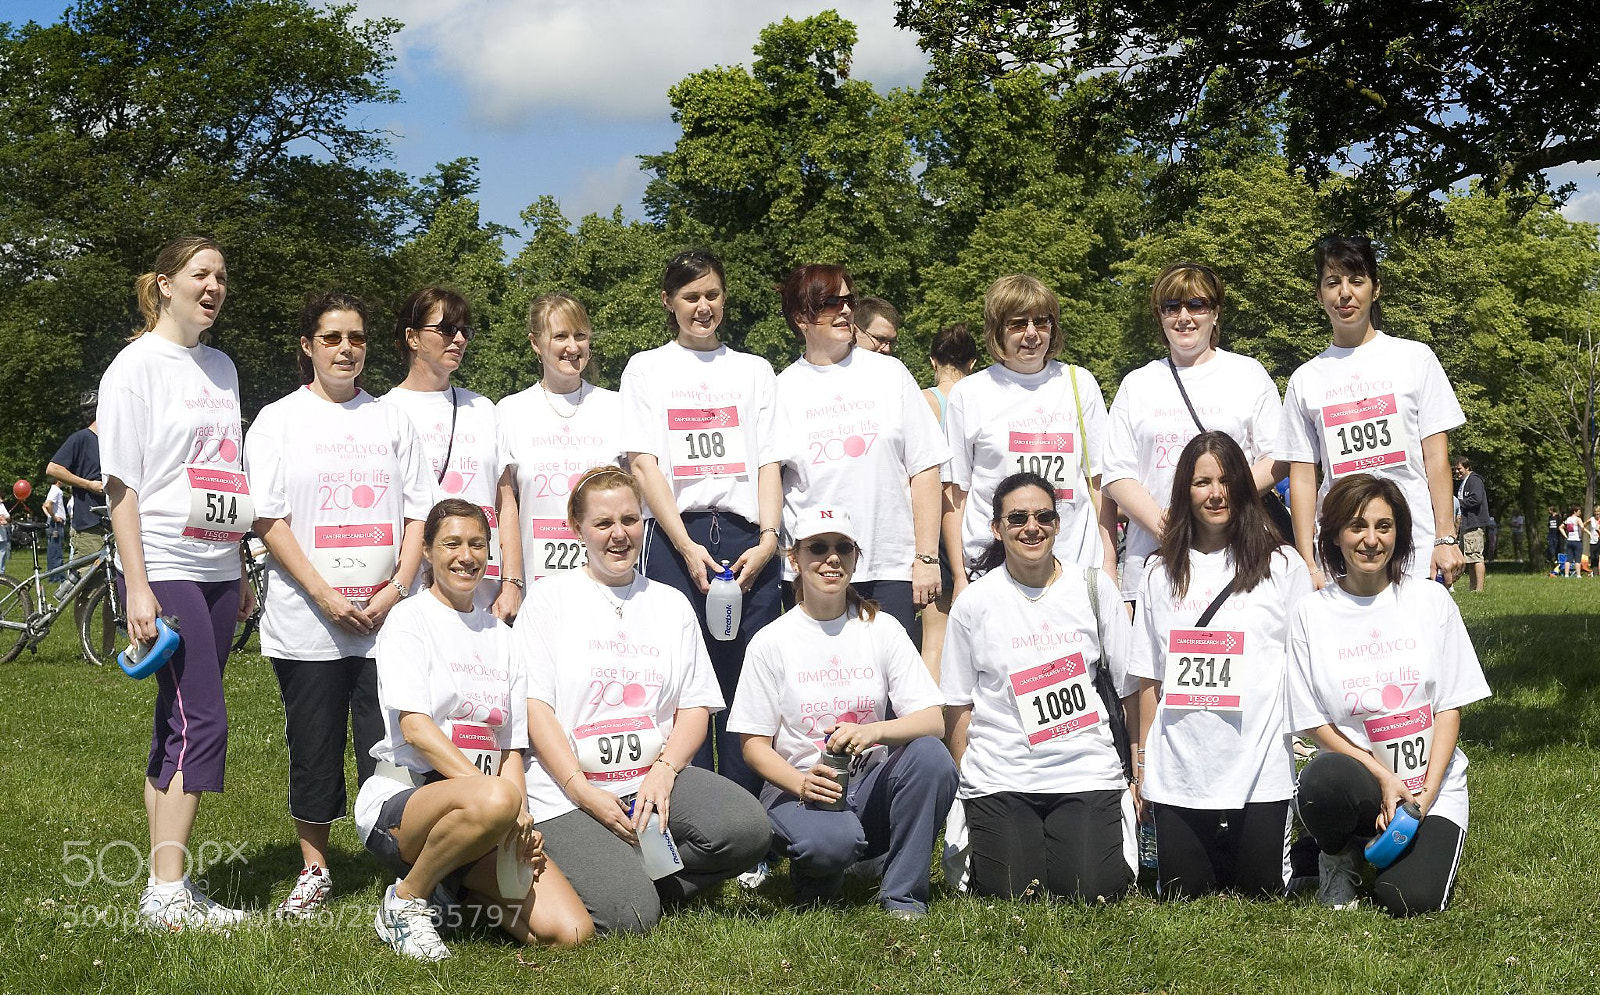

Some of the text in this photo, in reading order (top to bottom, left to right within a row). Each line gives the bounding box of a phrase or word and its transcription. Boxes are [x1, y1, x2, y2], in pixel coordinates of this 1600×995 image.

[671, 390, 742, 403] BMPOLYCO
[1324, 381, 1393, 401] BMPOLYCO
[184, 398, 235, 410] BMPOLYCO
[806, 400, 876, 420] BMPOLYCO
[195, 426, 214, 437] race
[216, 422, 229, 437] for
[808, 420, 880, 440] race for life
[1155, 433, 1179, 444] race
[1181, 429, 1196, 443] fo
[1337, 419, 1392, 456] 1993
[315, 443, 388, 456] BMPOLYCO
[532, 435, 604, 447] BMPOLYCO
[685, 431, 726, 460] 108
[808, 433, 879, 465] 2007
[460, 456, 479, 471] life
[533, 462, 560, 473] race
[563, 459, 582, 471] for
[694, 465, 725, 473] TESCO
[1016, 455, 1065, 482] 1072
[1354, 455, 1385, 467] TESCO
[317, 468, 390, 484] race for life
[318, 483, 389, 511] 2007
[205, 493, 238, 525] 514
[820, 509, 834, 519] N
[203, 531, 230, 539] TESCO
[339, 587, 373, 595] TESCO
[724, 604, 732, 637] Reebok
[589, 640, 660, 657] BMPOLYCO
[1011, 631, 1083, 649] BMPOLYCO
[1338, 638, 1417, 660] BMPOLYCO
[449, 662, 510, 681] BMPOLYCO
[591, 666, 663, 684] race for life
[798, 667, 874, 683] BMPOLYCO
[1177, 657, 1231, 688] 2314
[1342, 665, 1420, 690] race for life
[483, 690, 499, 705] for
[589, 680, 663, 708] 2007
[1188, 695, 1219, 704] TESCO
[1345, 682, 1419, 717] 2007
[801, 695, 876, 714] race for life
[1032, 683, 1086, 726] 1080
[1048, 720, 1079, 734] TESCO
[597, 733, 642, 765] 979
[1386, 736, 1428, 774] 782
[605, 770, 639, 781] TESCO
